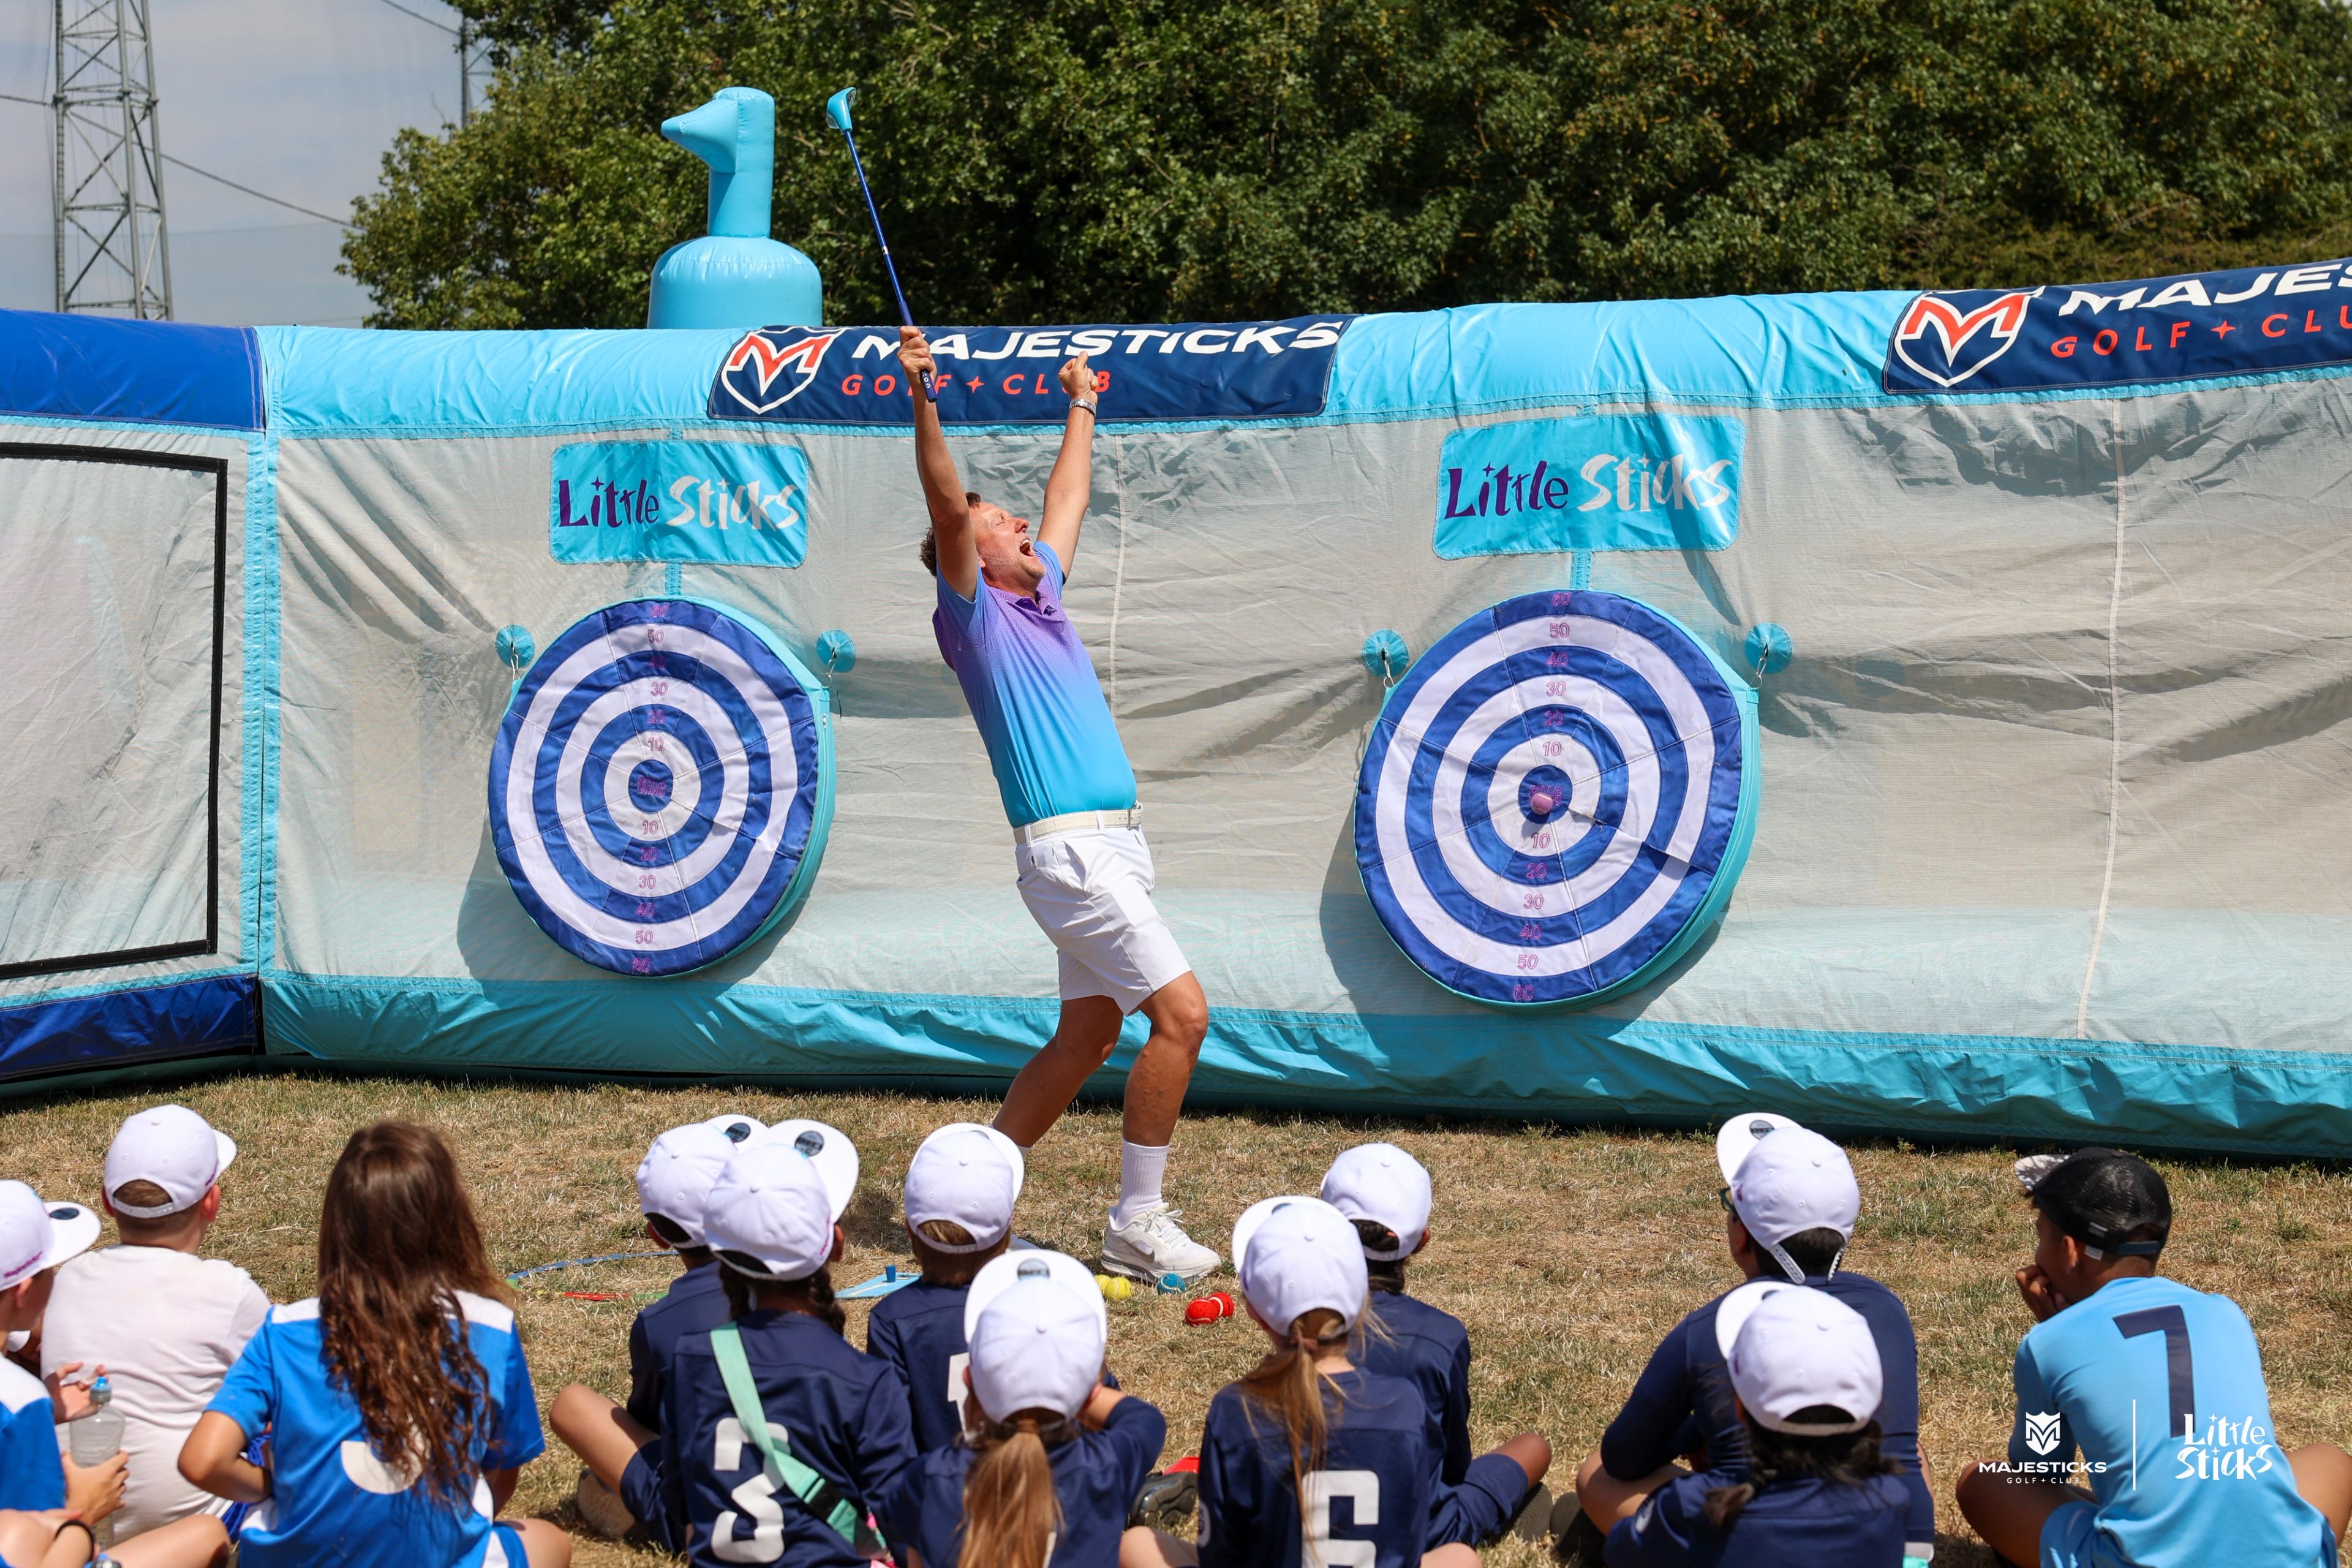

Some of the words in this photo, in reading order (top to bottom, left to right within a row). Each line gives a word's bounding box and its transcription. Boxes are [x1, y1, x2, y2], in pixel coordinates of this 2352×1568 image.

[2059, 263, 2352, 317] MAJE
[2050, 321, 2190, 358] GOLF
[842, 374, 952, 396] GOF
[1003, 371, 1110, 396] CLB
[1444, 460, 1569, 520] Little
[1577, 452, 1732, 512] Sticks
[558, 475, 659, 528] Little
[665, 475, 800, 532] Sticks
[1551, 591, 1572, 607] 60
[651, 605, 669, 618] 60
[647, 628, 664, 644] 50
[1549, 623, 1570, 639] 50
[1547, 652, 1568, 668] 40
[650, 682, 668, 696] 30
[1545, 681, 1567, 696] 30
[647, 710, 666, 724] 20
[1544, 710, 1565, 726] 20
[648, 737, 663, 752] 10
[1543, 741, 1562, 756] 10
[642, 821, 658, 835] 10
[1531, 833, 1551, 848] 10
[640, 847, 658, 861] 20
[1526, 862, 1547, 879] 20
[638, 875, 657, 889] 30
[636, 903, 655, 917] 40
[1523, 894, 1544, 910] 30
[635, 930, 654, 944] 50
[1520, 924, 1542, 940] 40
[633, 958, 652, 973] 60
[1517, 954, 1539, 970] 50
[1513, 985, 1534, 1000] 60
[2112, 1304, 2196, 1438] 7
